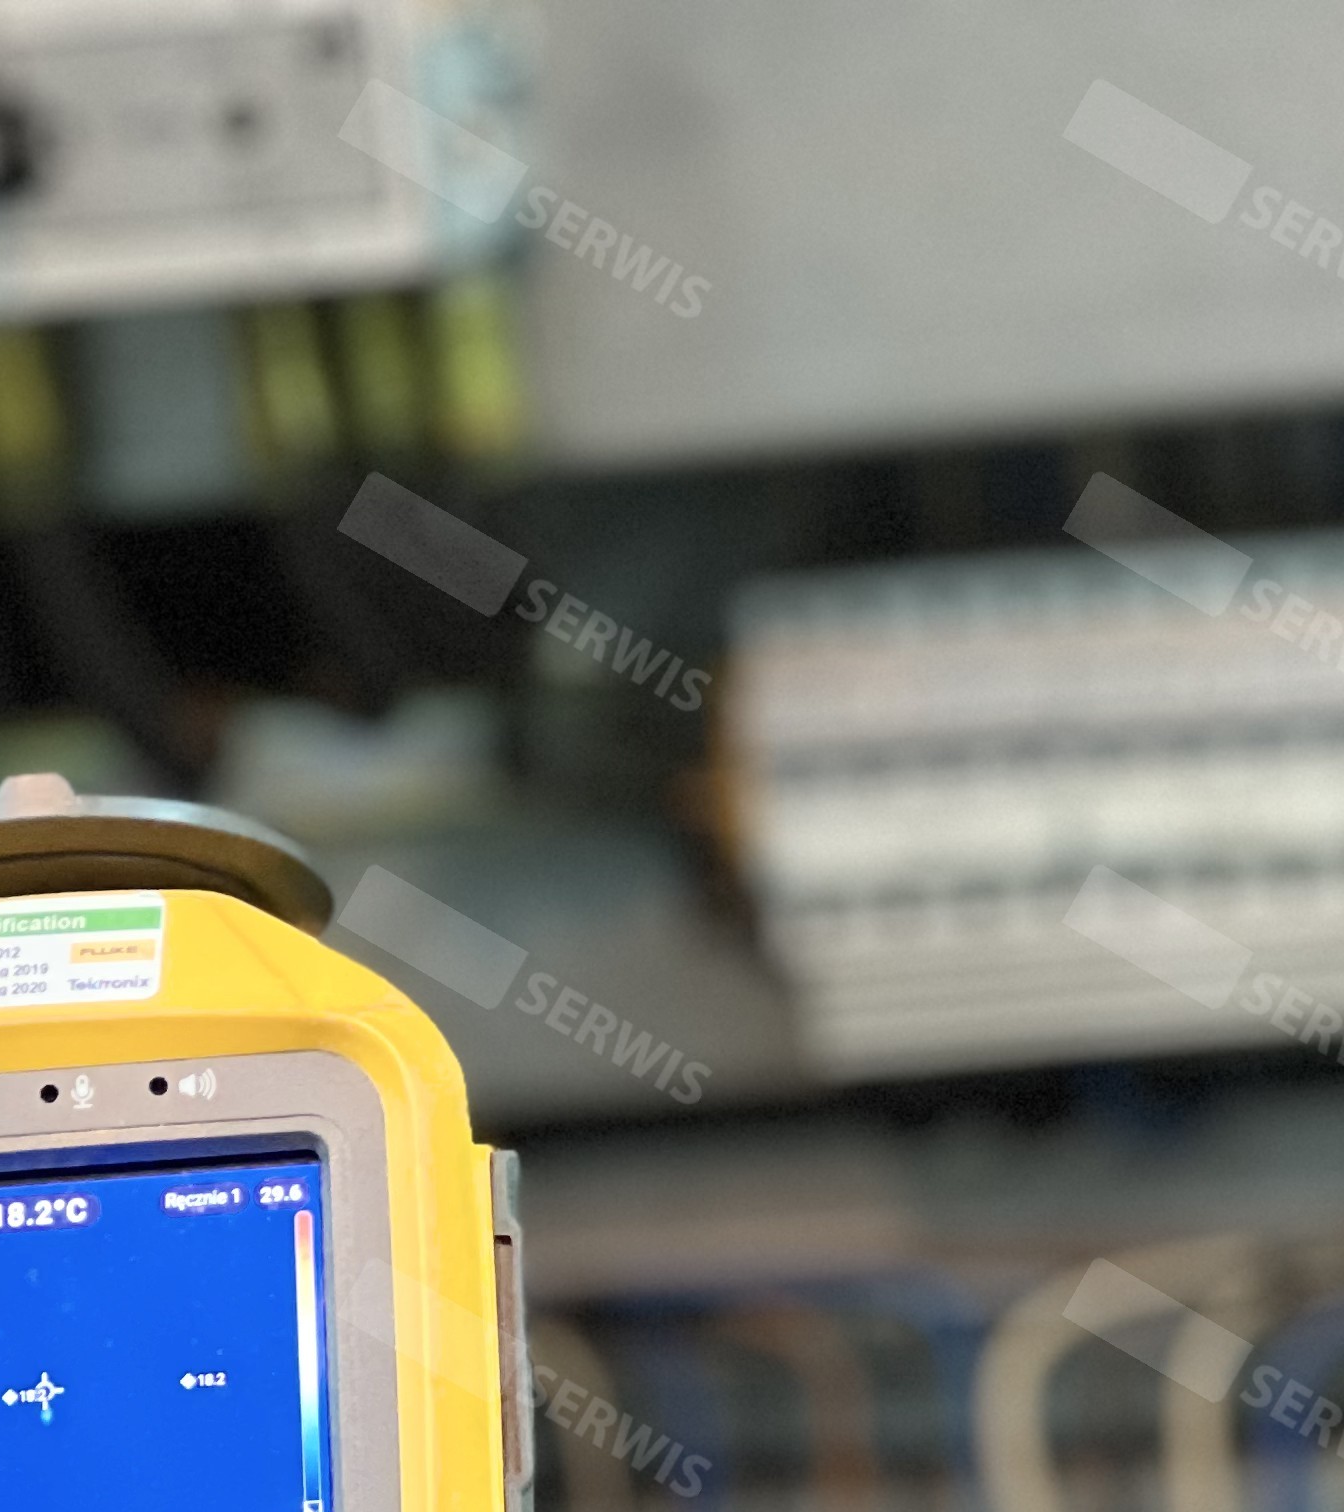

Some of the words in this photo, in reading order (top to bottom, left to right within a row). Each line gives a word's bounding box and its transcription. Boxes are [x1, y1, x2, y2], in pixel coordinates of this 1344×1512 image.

[80, 945, 138, 956] FLUKE
[12, 963, 49, 976] 2019
[12, 981, 48, 994] 2020
[67, 974, 149, 991] Tektronix
[231, 1187, 241, 1203] 1
[260, 1183, 303, 1204] 29.6
